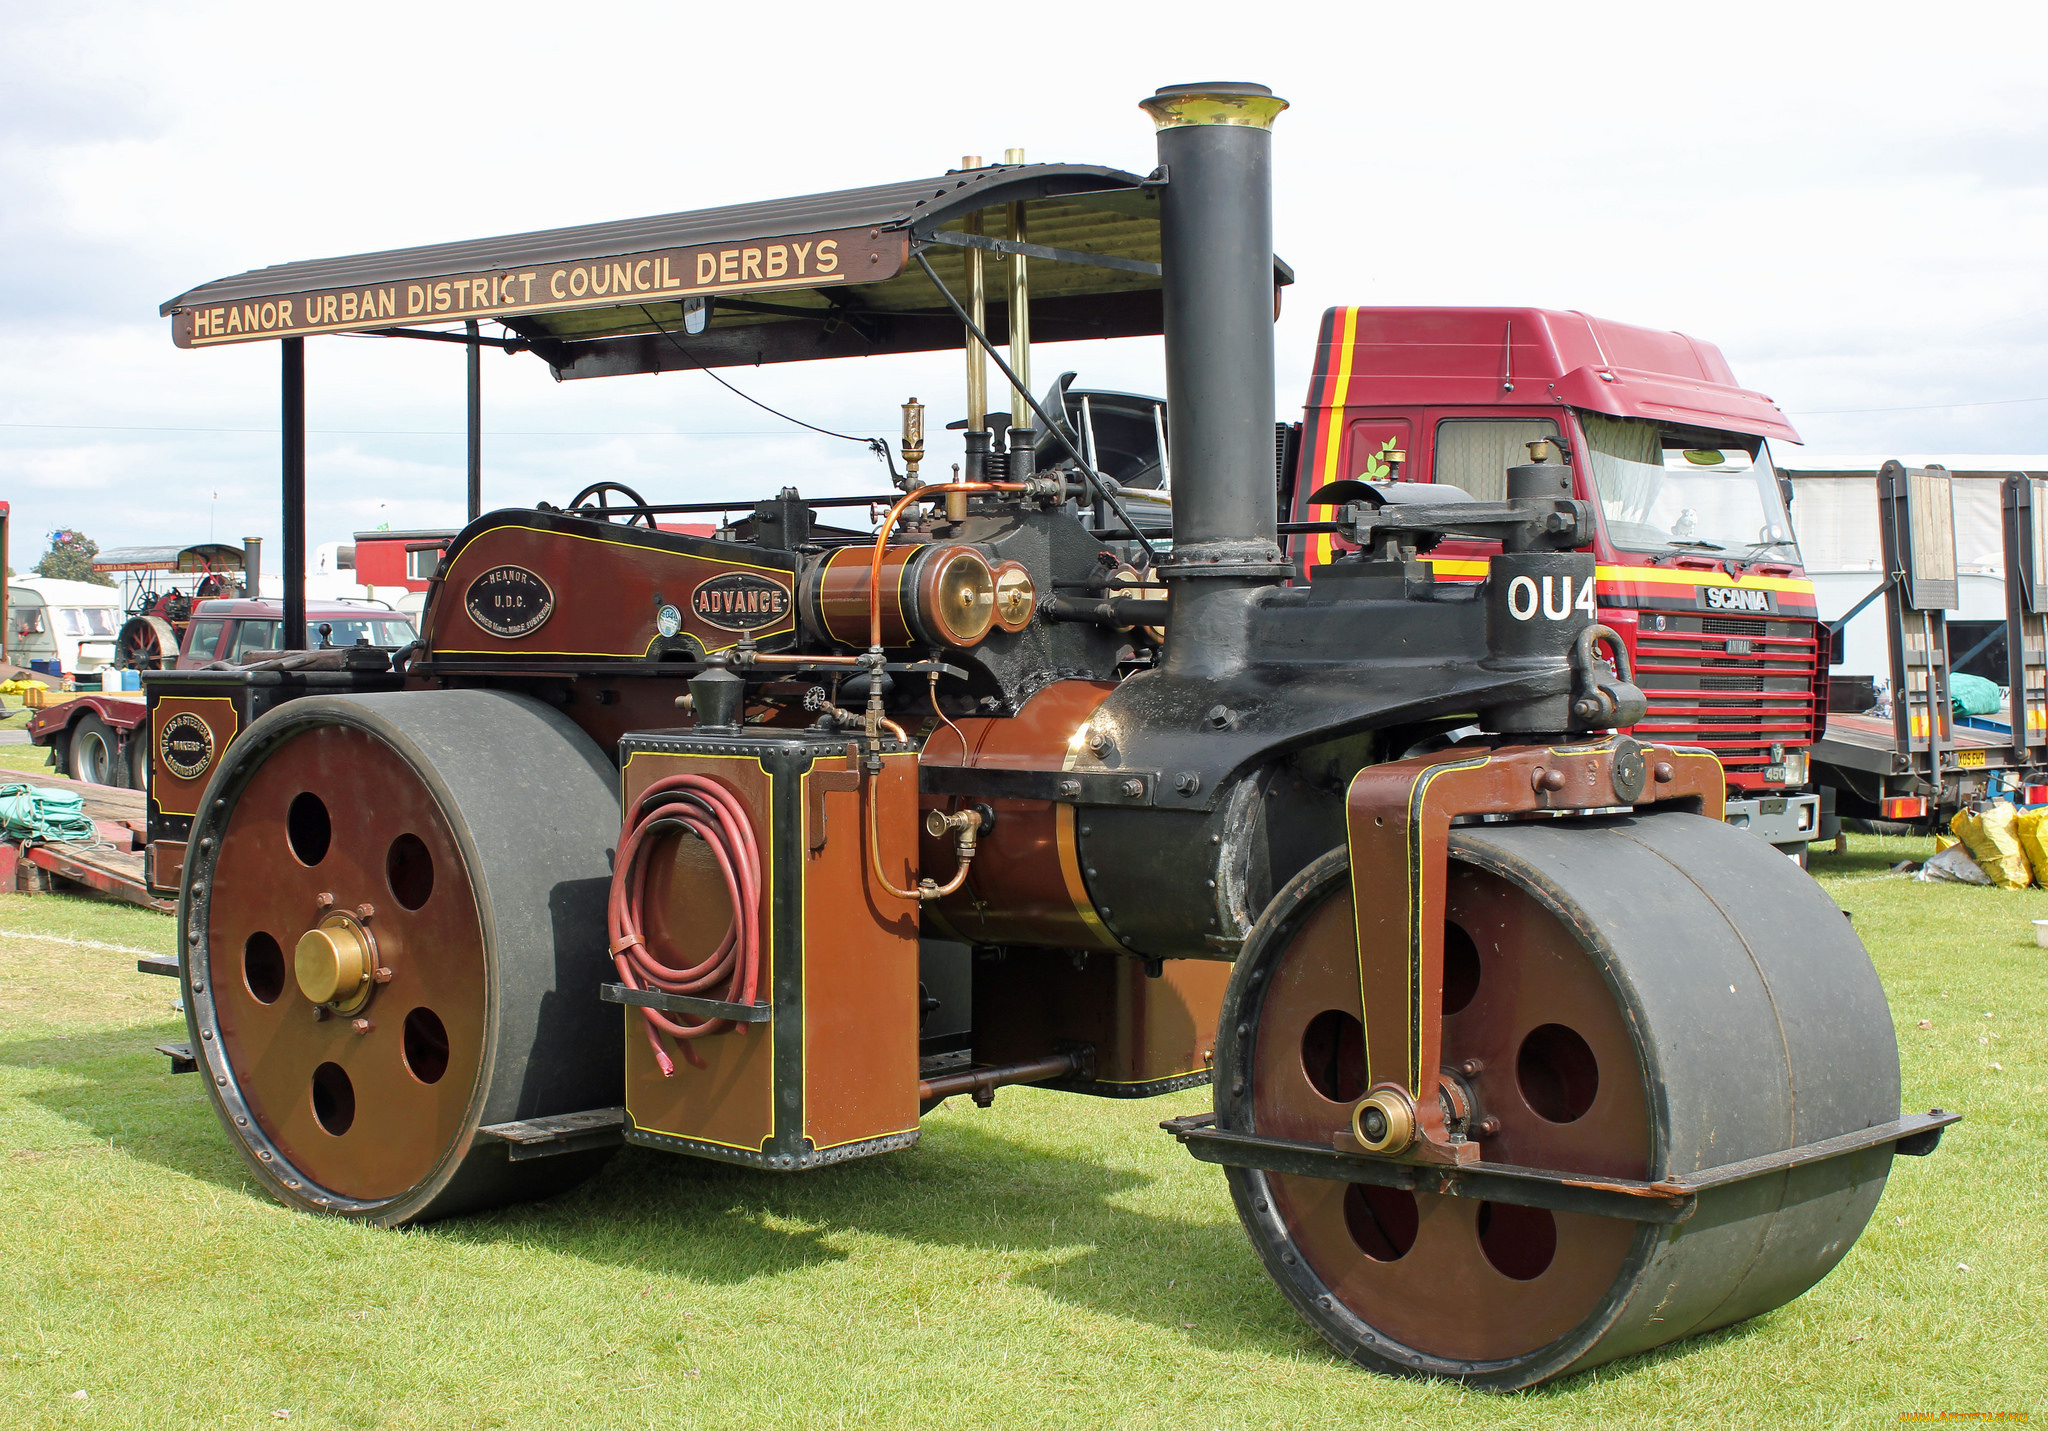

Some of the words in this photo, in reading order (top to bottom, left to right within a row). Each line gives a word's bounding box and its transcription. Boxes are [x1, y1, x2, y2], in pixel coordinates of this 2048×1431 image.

[194, 299, 294, 337] HEANOR
[306, 287, 396, 325] URBAN
[408, 271, 537, 315] DISTRICT
[550, 256, 681, 300] COUNCIL
[696, 239, 839, 286] DERBYS
[488, 570, 528, 585] HEANOR
[494, 595, 526, 608] U.D.C.
[699, 590, 783, 613] ADVANCE
[1507, 575, 1598, 621] OU4
[1707, 587, 1770, 611] SCANIA
[173, 740, 201, 752] MAKERS
[1766, 767, 1785, 781] 450
